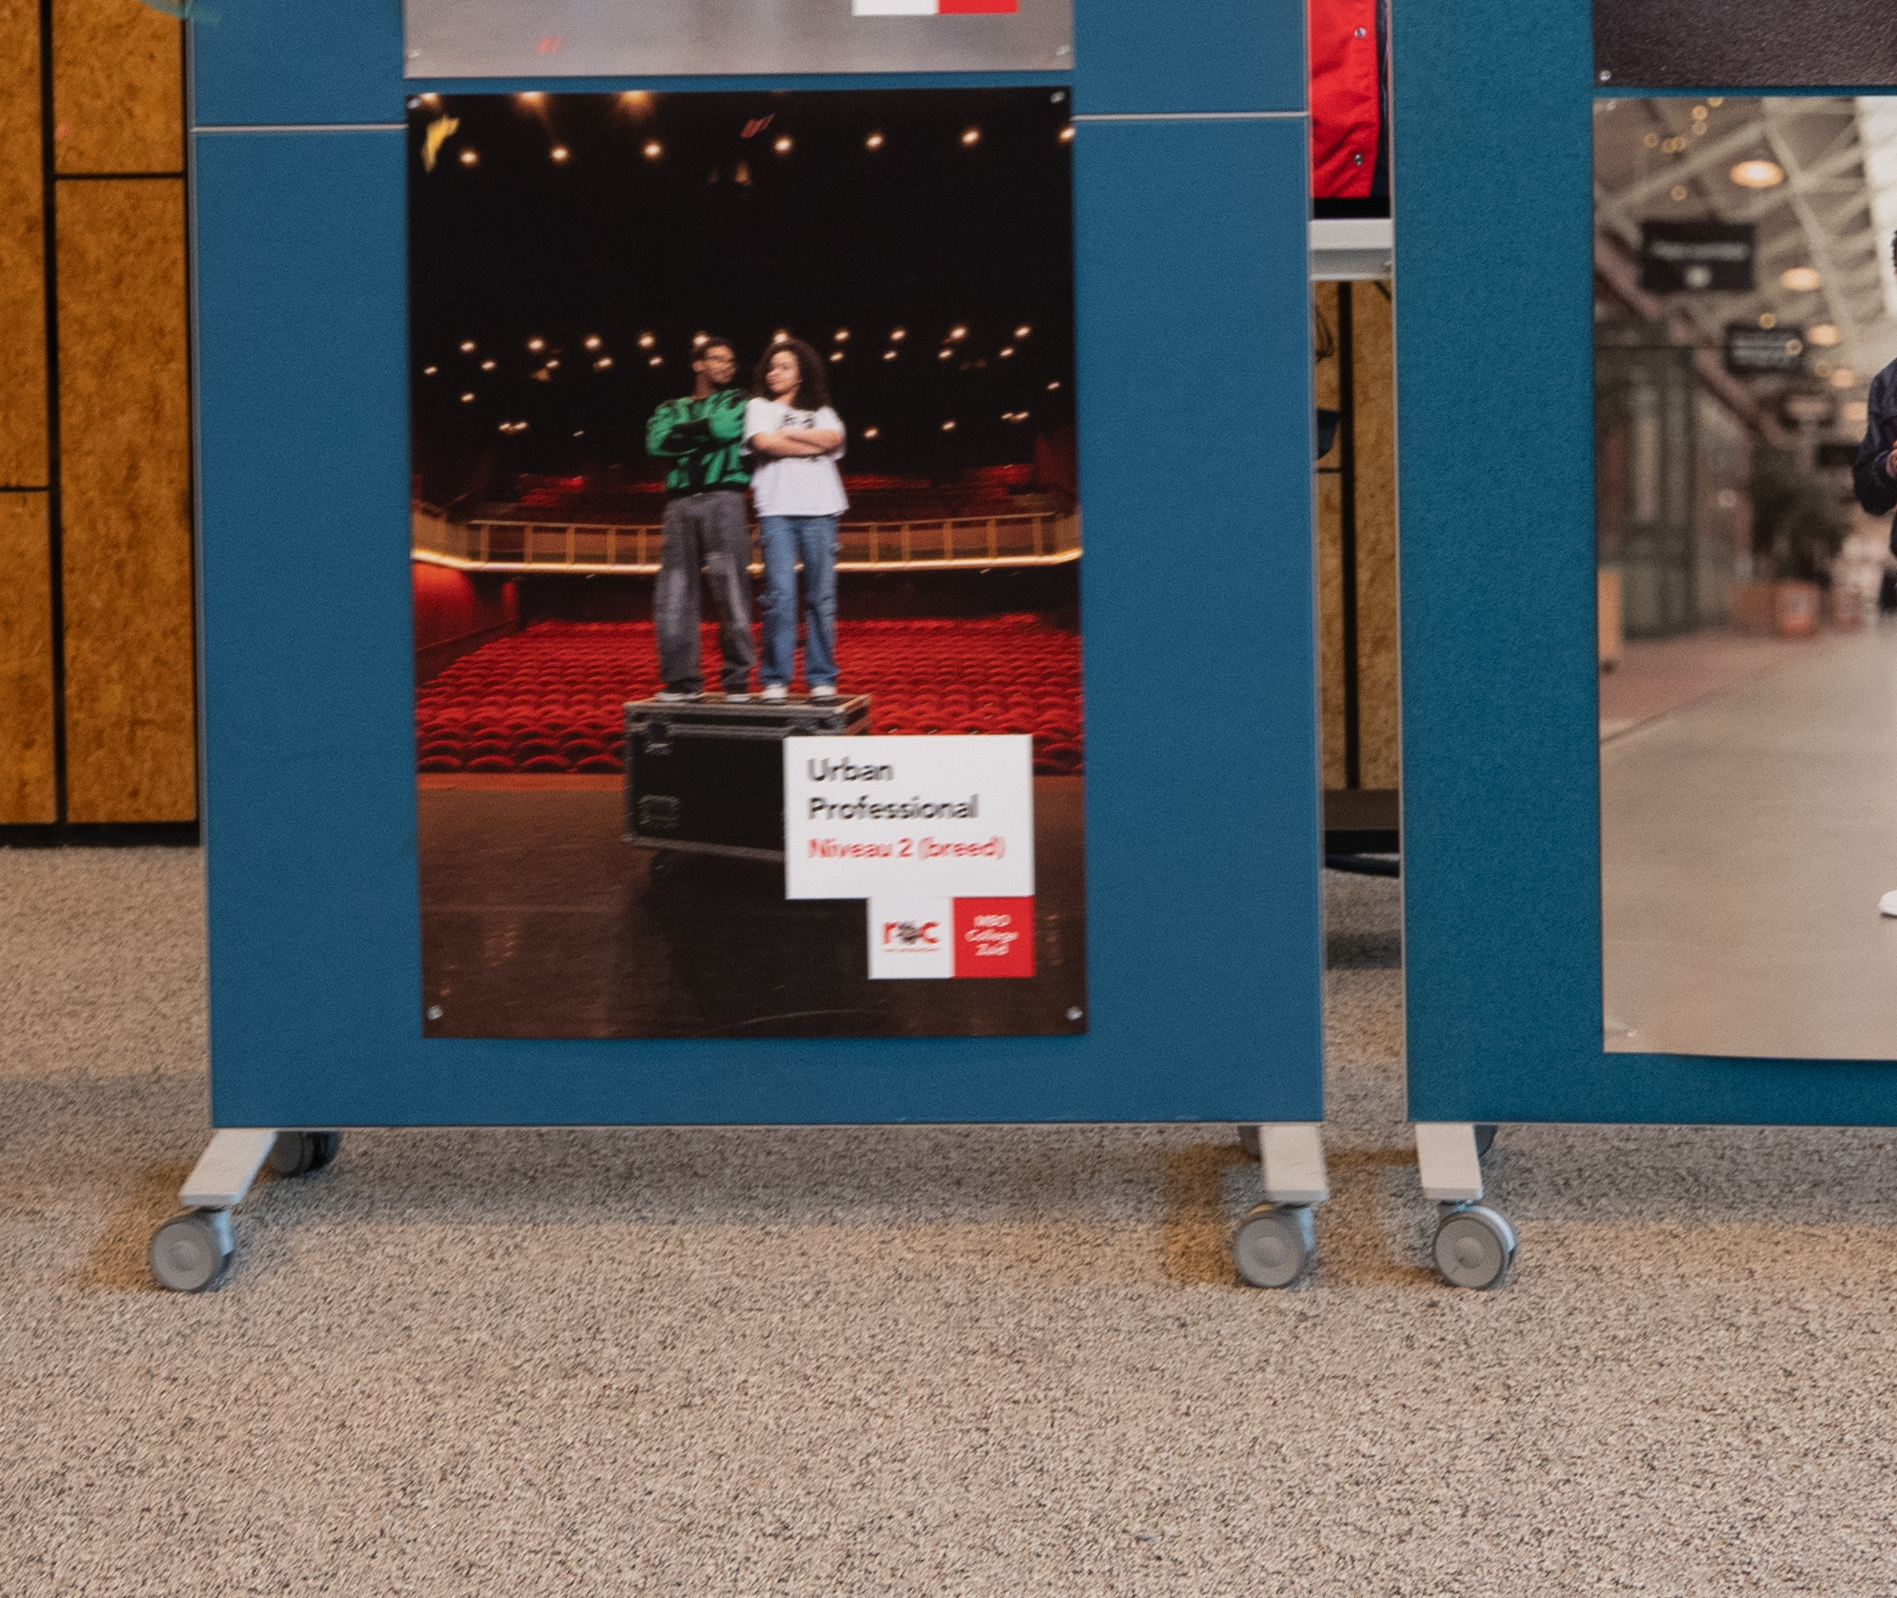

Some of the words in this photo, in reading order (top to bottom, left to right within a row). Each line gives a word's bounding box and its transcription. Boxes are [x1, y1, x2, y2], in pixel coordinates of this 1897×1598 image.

[808, 757, 893, 782] Urban
[808, 793, 978, 820] Professional
[808, 838, 893, 859] Niveau
[898, 837, 914, 858] 2
[917, 835, 1006, 860] (breed)
